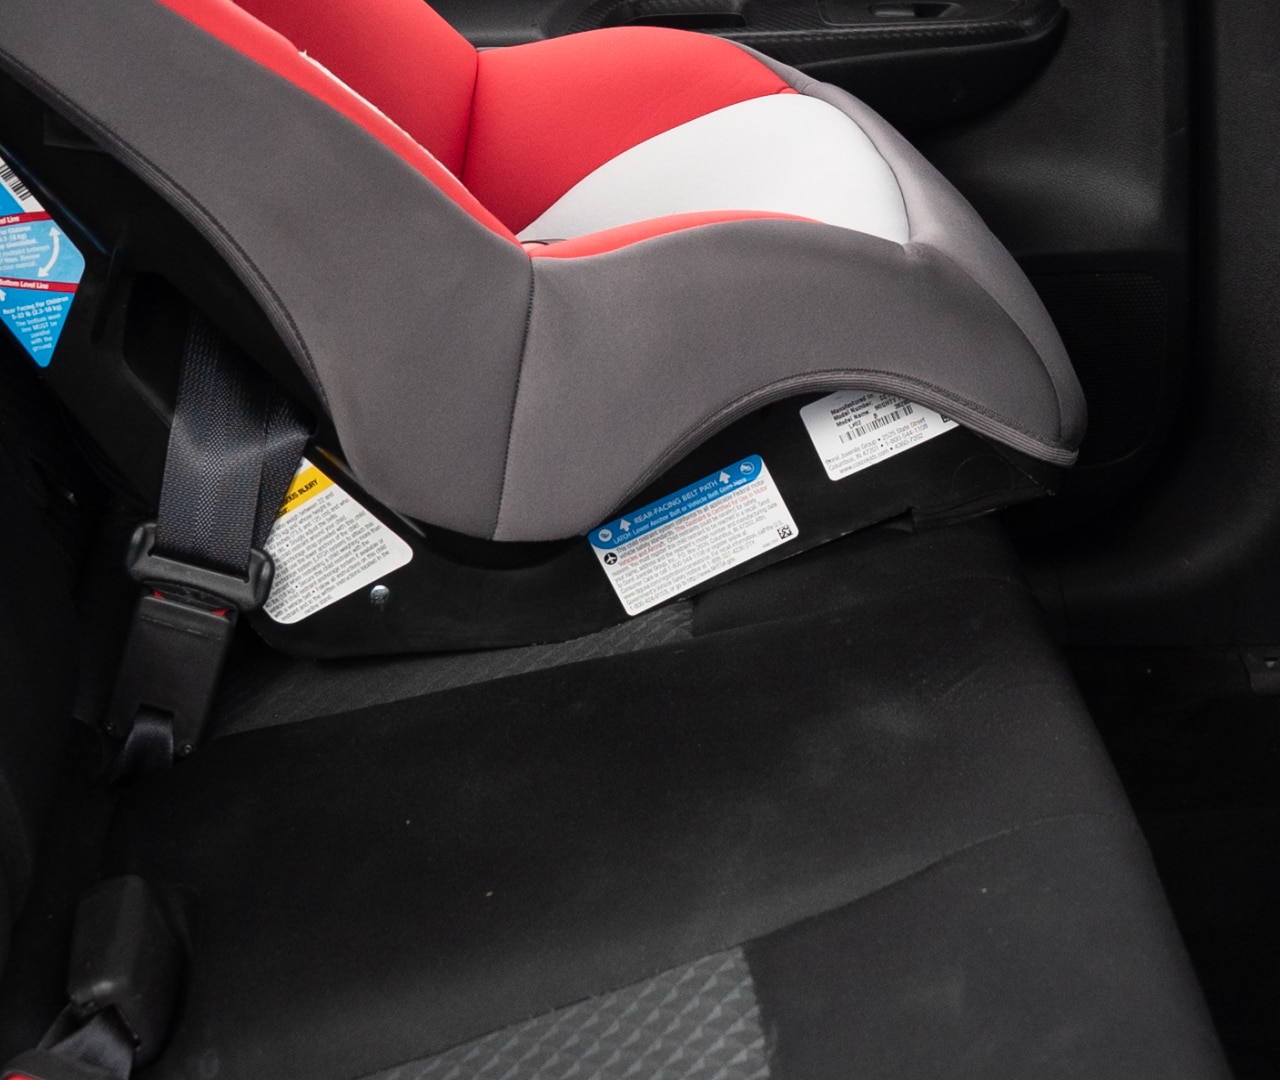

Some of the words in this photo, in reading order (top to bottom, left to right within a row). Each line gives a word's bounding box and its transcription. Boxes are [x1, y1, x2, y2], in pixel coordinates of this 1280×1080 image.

[632, 523, 649, 535] Lower
[649, 513, 668, 526] Anchor
[669, 507, 681, 517] Belt
[687, 495, 707, 508] Vehicle
[707, 489, 718, 498] Belt
[633, 496, 681, 524] REAR-FACING
[681, 488, 698, 501] BELT
[698, 479, 717, 492] PATH
